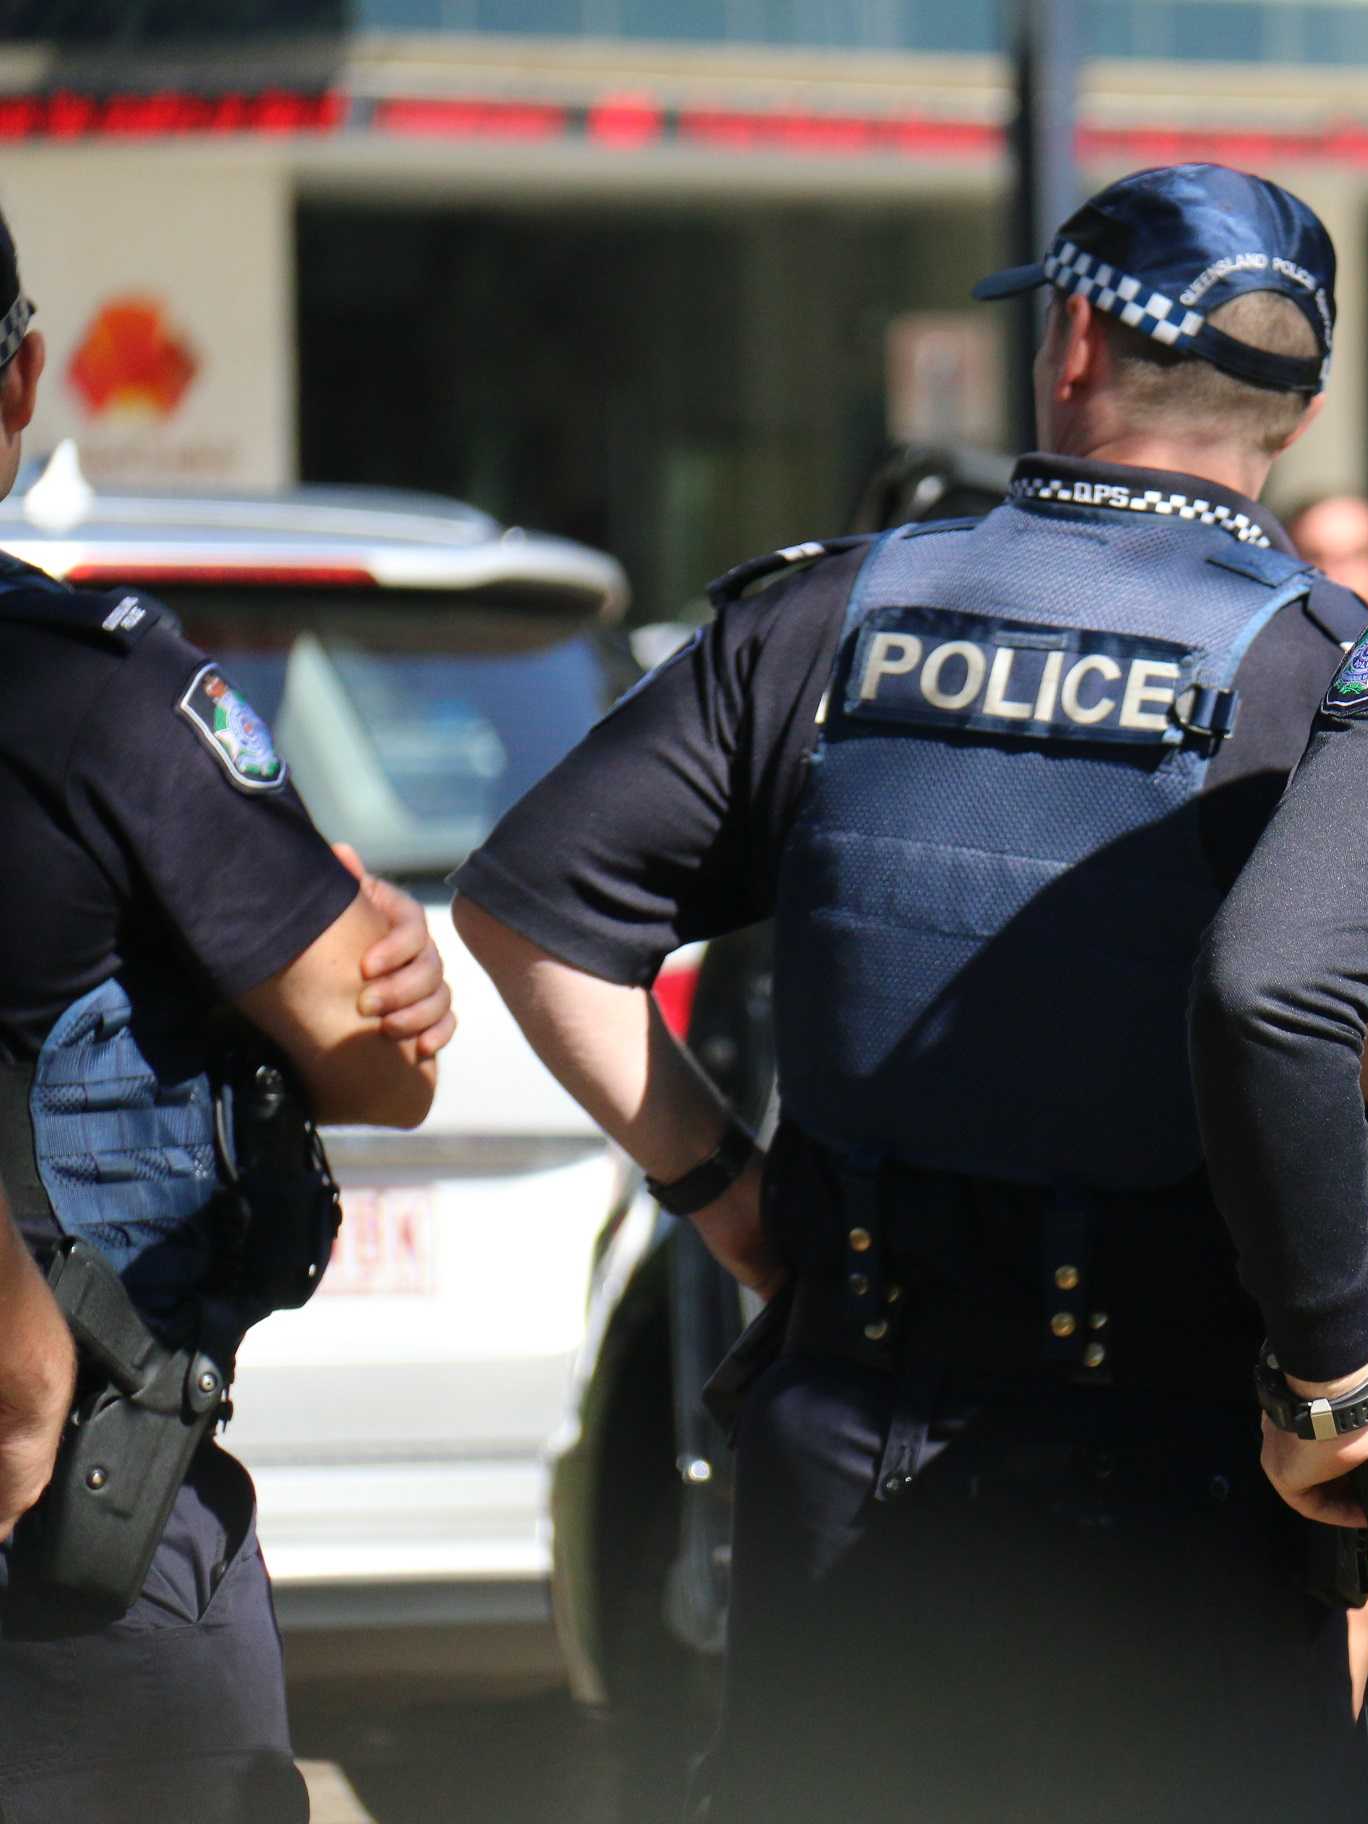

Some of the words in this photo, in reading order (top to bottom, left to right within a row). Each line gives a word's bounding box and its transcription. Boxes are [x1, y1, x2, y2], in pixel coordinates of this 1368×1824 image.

[1179, 253, 1269, 305] QUEENSLAND
[1272, 256, 1317, 291] POLICE
[1073, 482, 1130, 508] QPS
[859, 632, 1180, 730] POLICE
